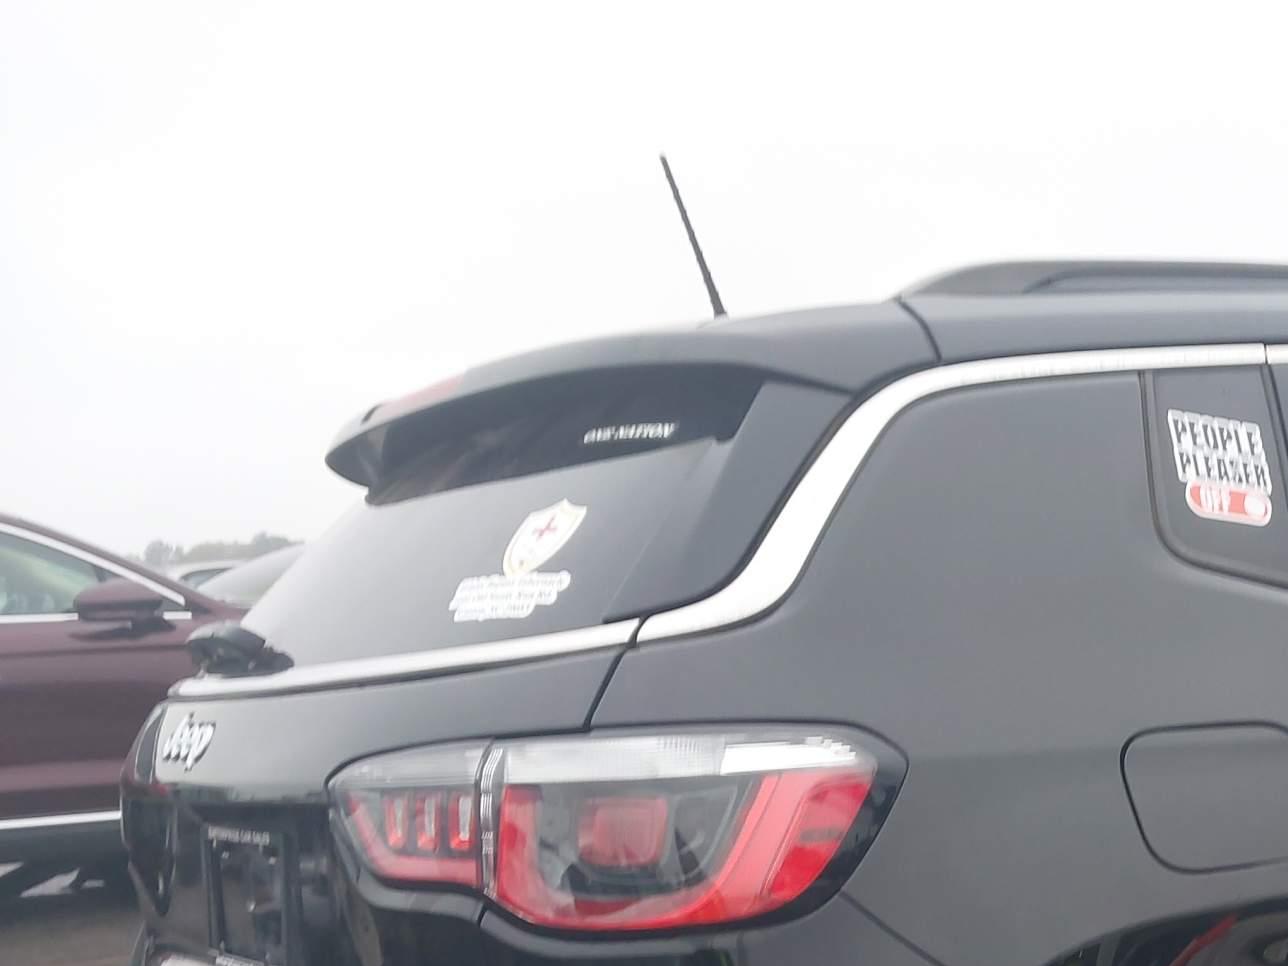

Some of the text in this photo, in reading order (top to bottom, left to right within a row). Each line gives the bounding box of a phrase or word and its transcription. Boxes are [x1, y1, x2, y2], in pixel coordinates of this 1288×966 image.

[1170, 413, 1261, 458] PEOPLE
[1178, 450, 1269, 489] PLEASER
[162, 712, 216, 772] Jeep
